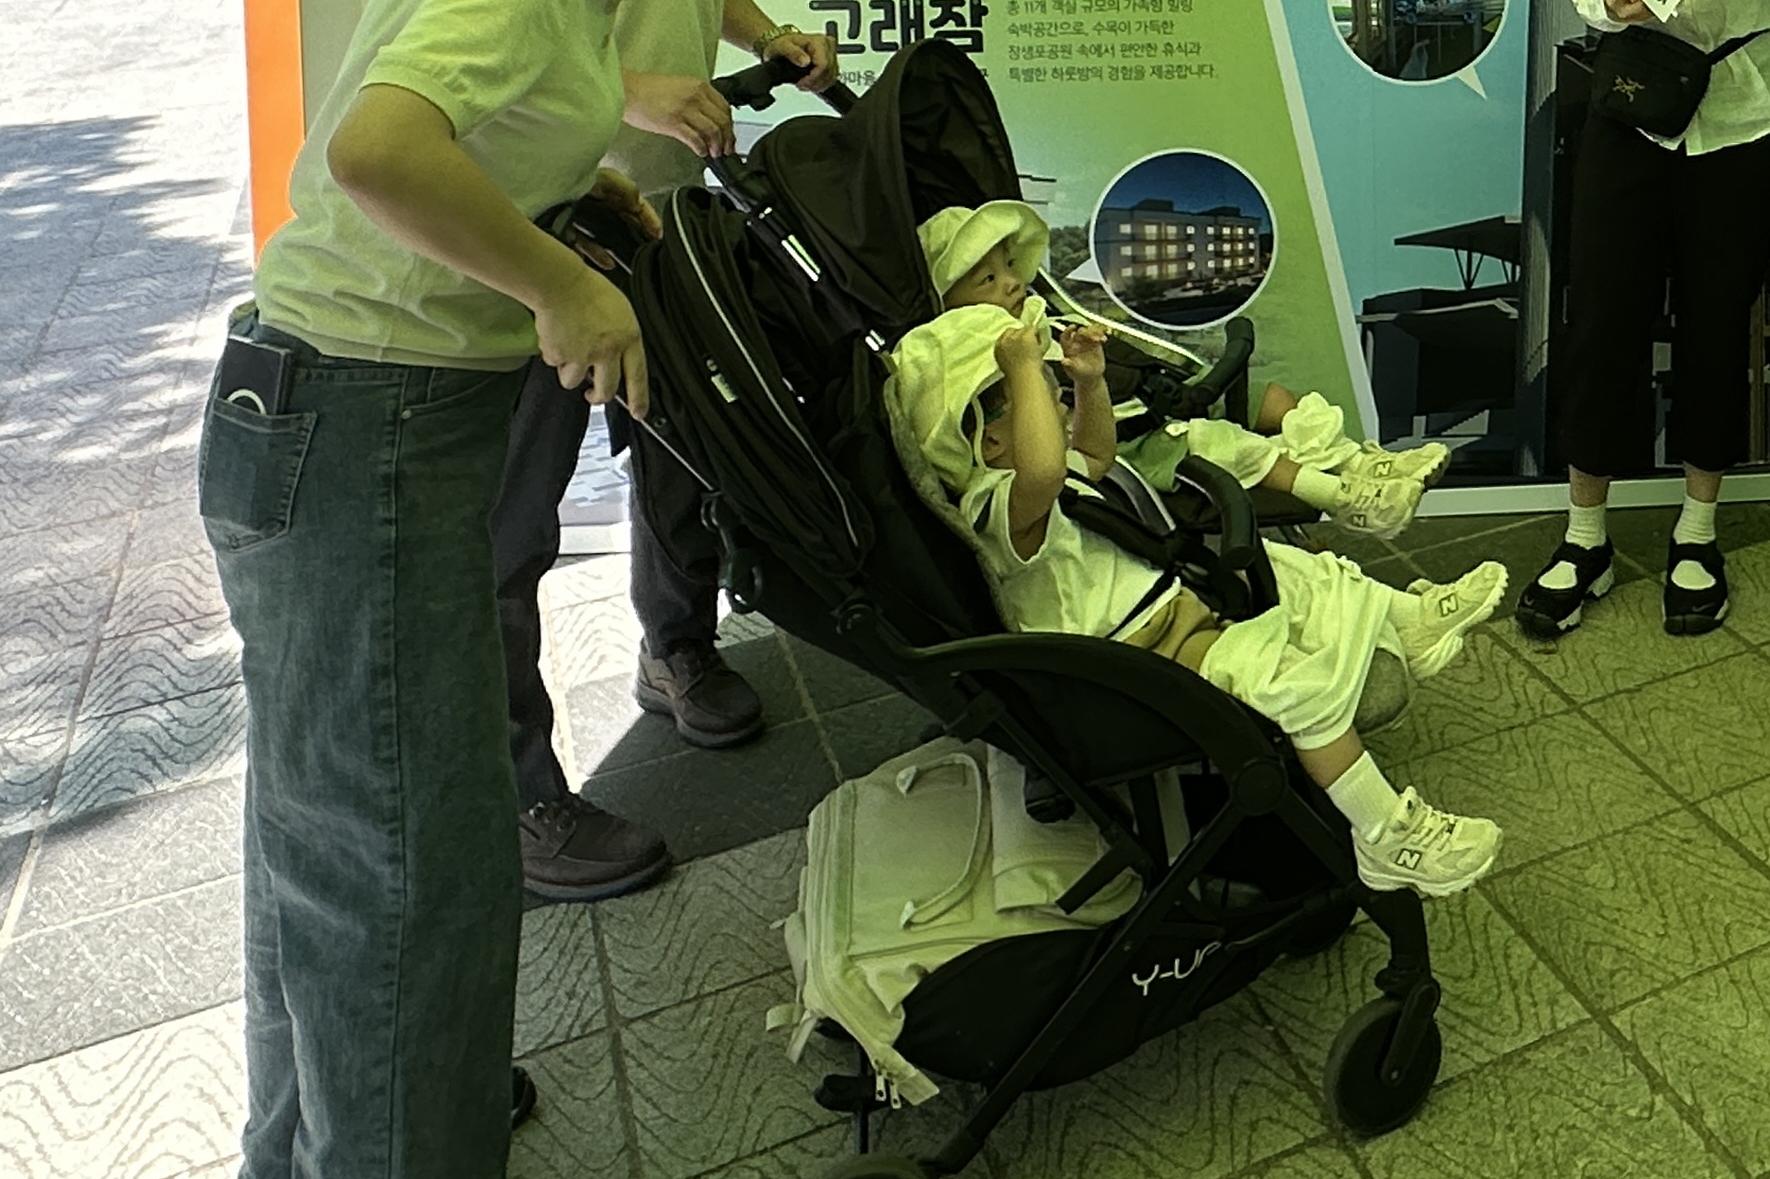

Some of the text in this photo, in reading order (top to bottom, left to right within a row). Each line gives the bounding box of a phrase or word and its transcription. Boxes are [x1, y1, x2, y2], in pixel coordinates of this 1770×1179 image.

[1373, 460, 1392, 478] N
[1438, 594, 1460, 618] N
[1396, 848, 1422, 870] N
